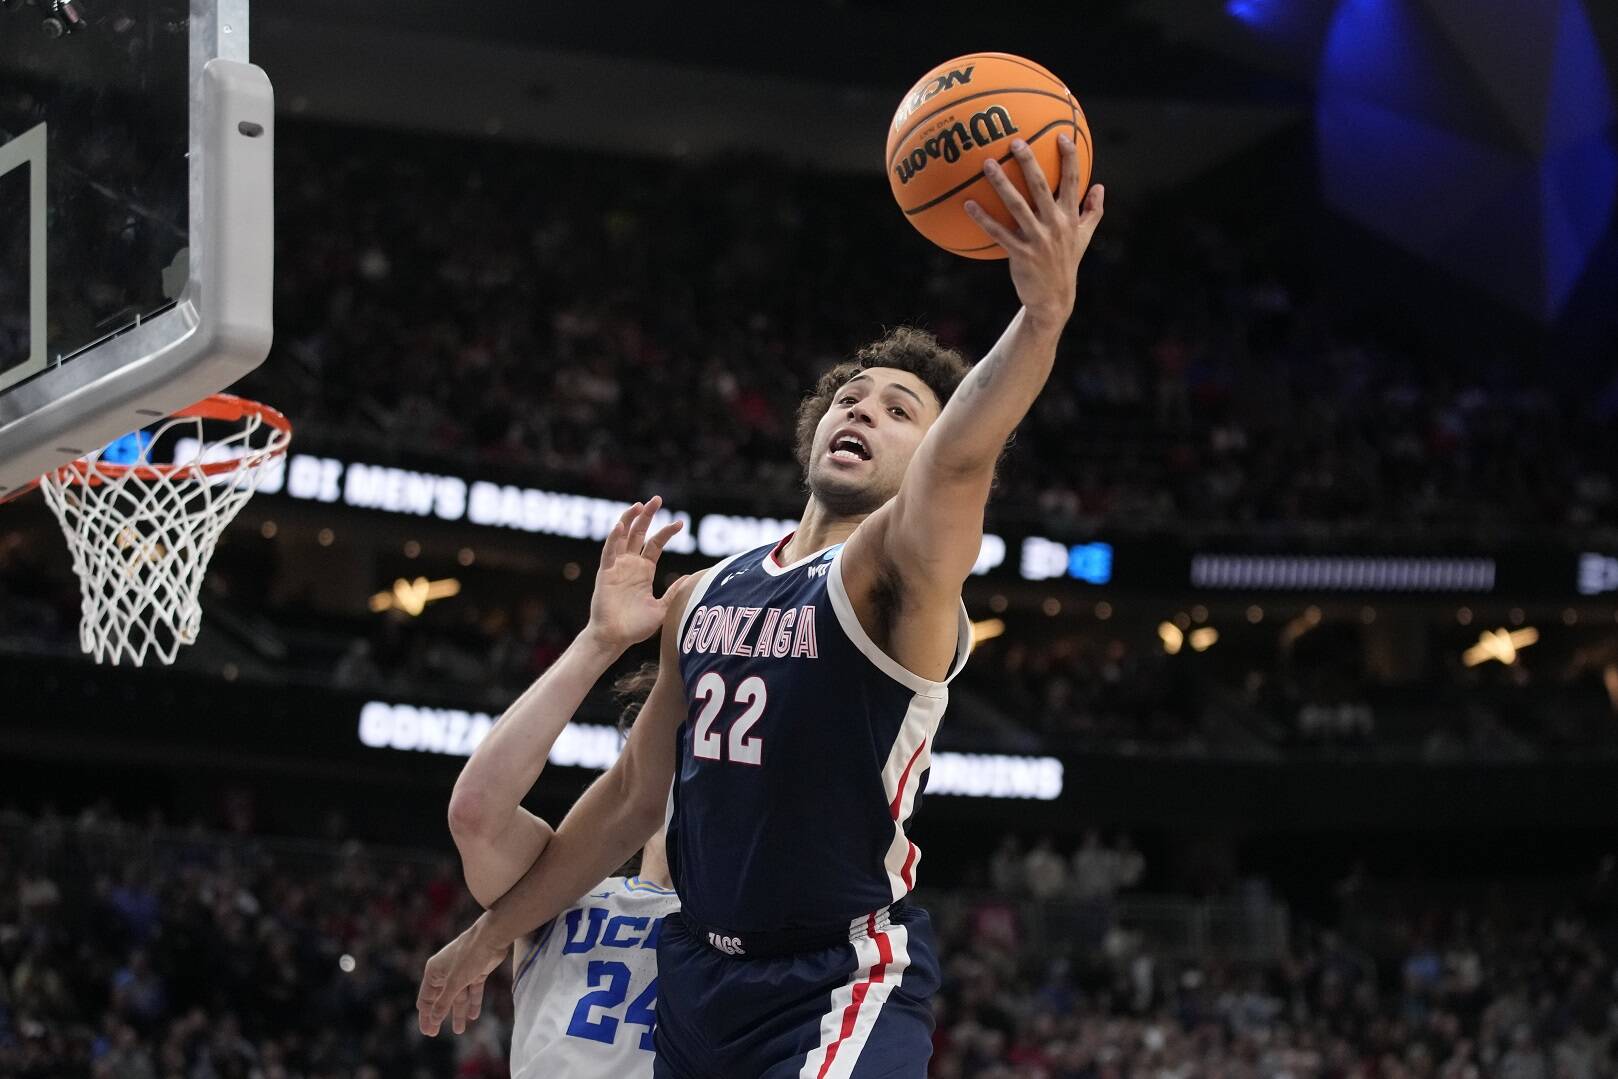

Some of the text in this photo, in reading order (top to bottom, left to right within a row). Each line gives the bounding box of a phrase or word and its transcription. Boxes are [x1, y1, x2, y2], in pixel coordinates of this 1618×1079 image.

[895, 104, 1019, 185] Wilson
[345, 460, 467, 520] MEN'S
[468, 481, 694, 554] BASKETLL
[682, 605, 818, 659] GONZAGA
[361, 703, 493, 754] GONZA
[692, 671, 768, 766] 22
[708, 931, 747, 956] ZAGS
[566, 961, 659, 1052] 24
